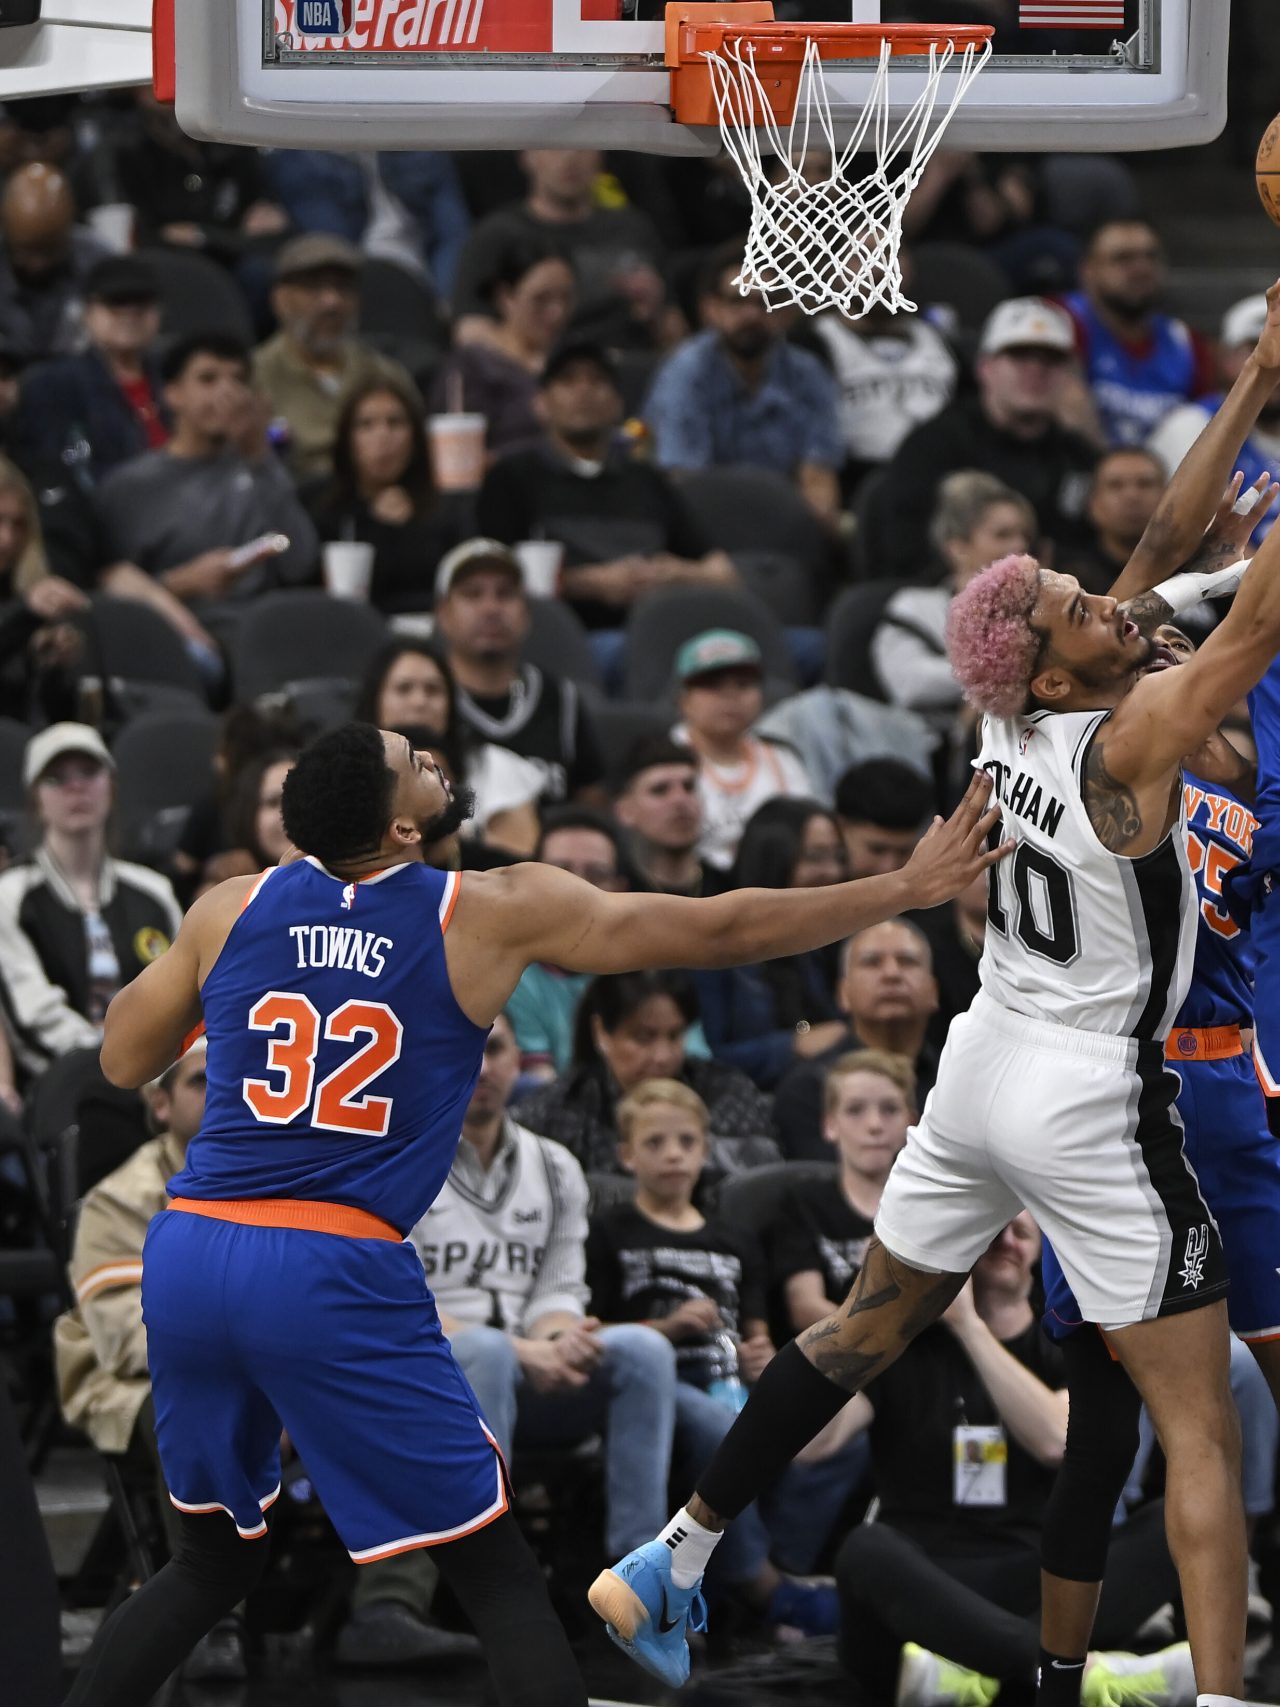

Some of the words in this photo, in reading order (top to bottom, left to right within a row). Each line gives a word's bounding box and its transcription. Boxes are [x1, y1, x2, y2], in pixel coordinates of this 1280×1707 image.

[303, 2, 332, 26] NBA
[982, 760, 1066, 839] CHAN
[1205, 794, 1262, 859] YOR
[985, 807, 1082, 969] 10
[289, 925, 393, 979] TOWNS
[242, 990, 404, 1138] 32
